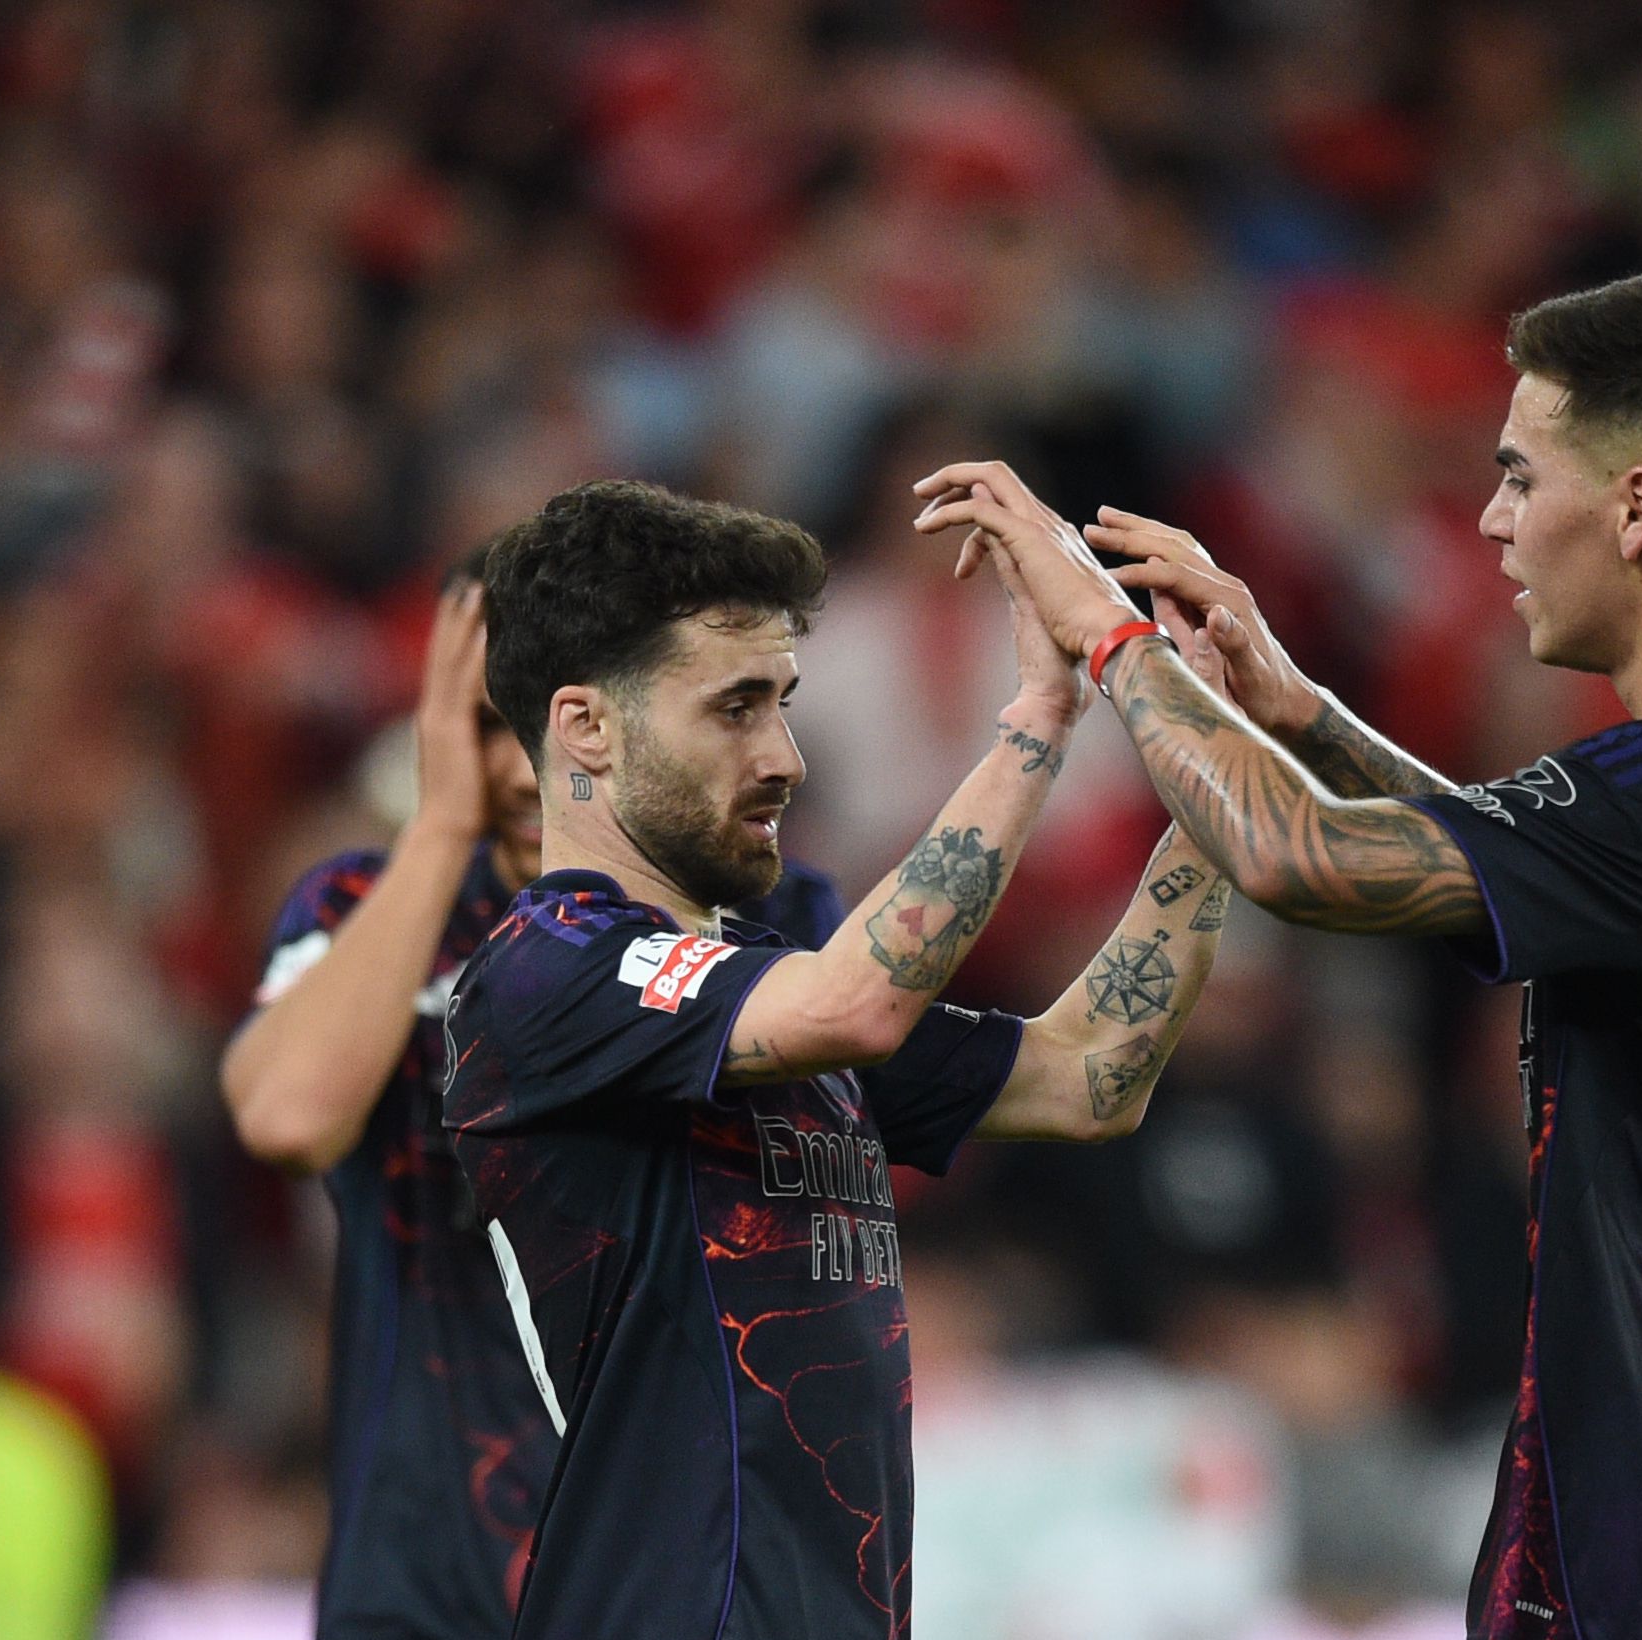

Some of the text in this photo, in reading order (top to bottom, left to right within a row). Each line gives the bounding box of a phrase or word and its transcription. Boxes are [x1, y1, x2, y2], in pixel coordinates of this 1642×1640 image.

[570, 773, 593, 801] D
[753, 1115, 895, 1209] Emira
[812, 1213, 904, 1292] FLY BETT
